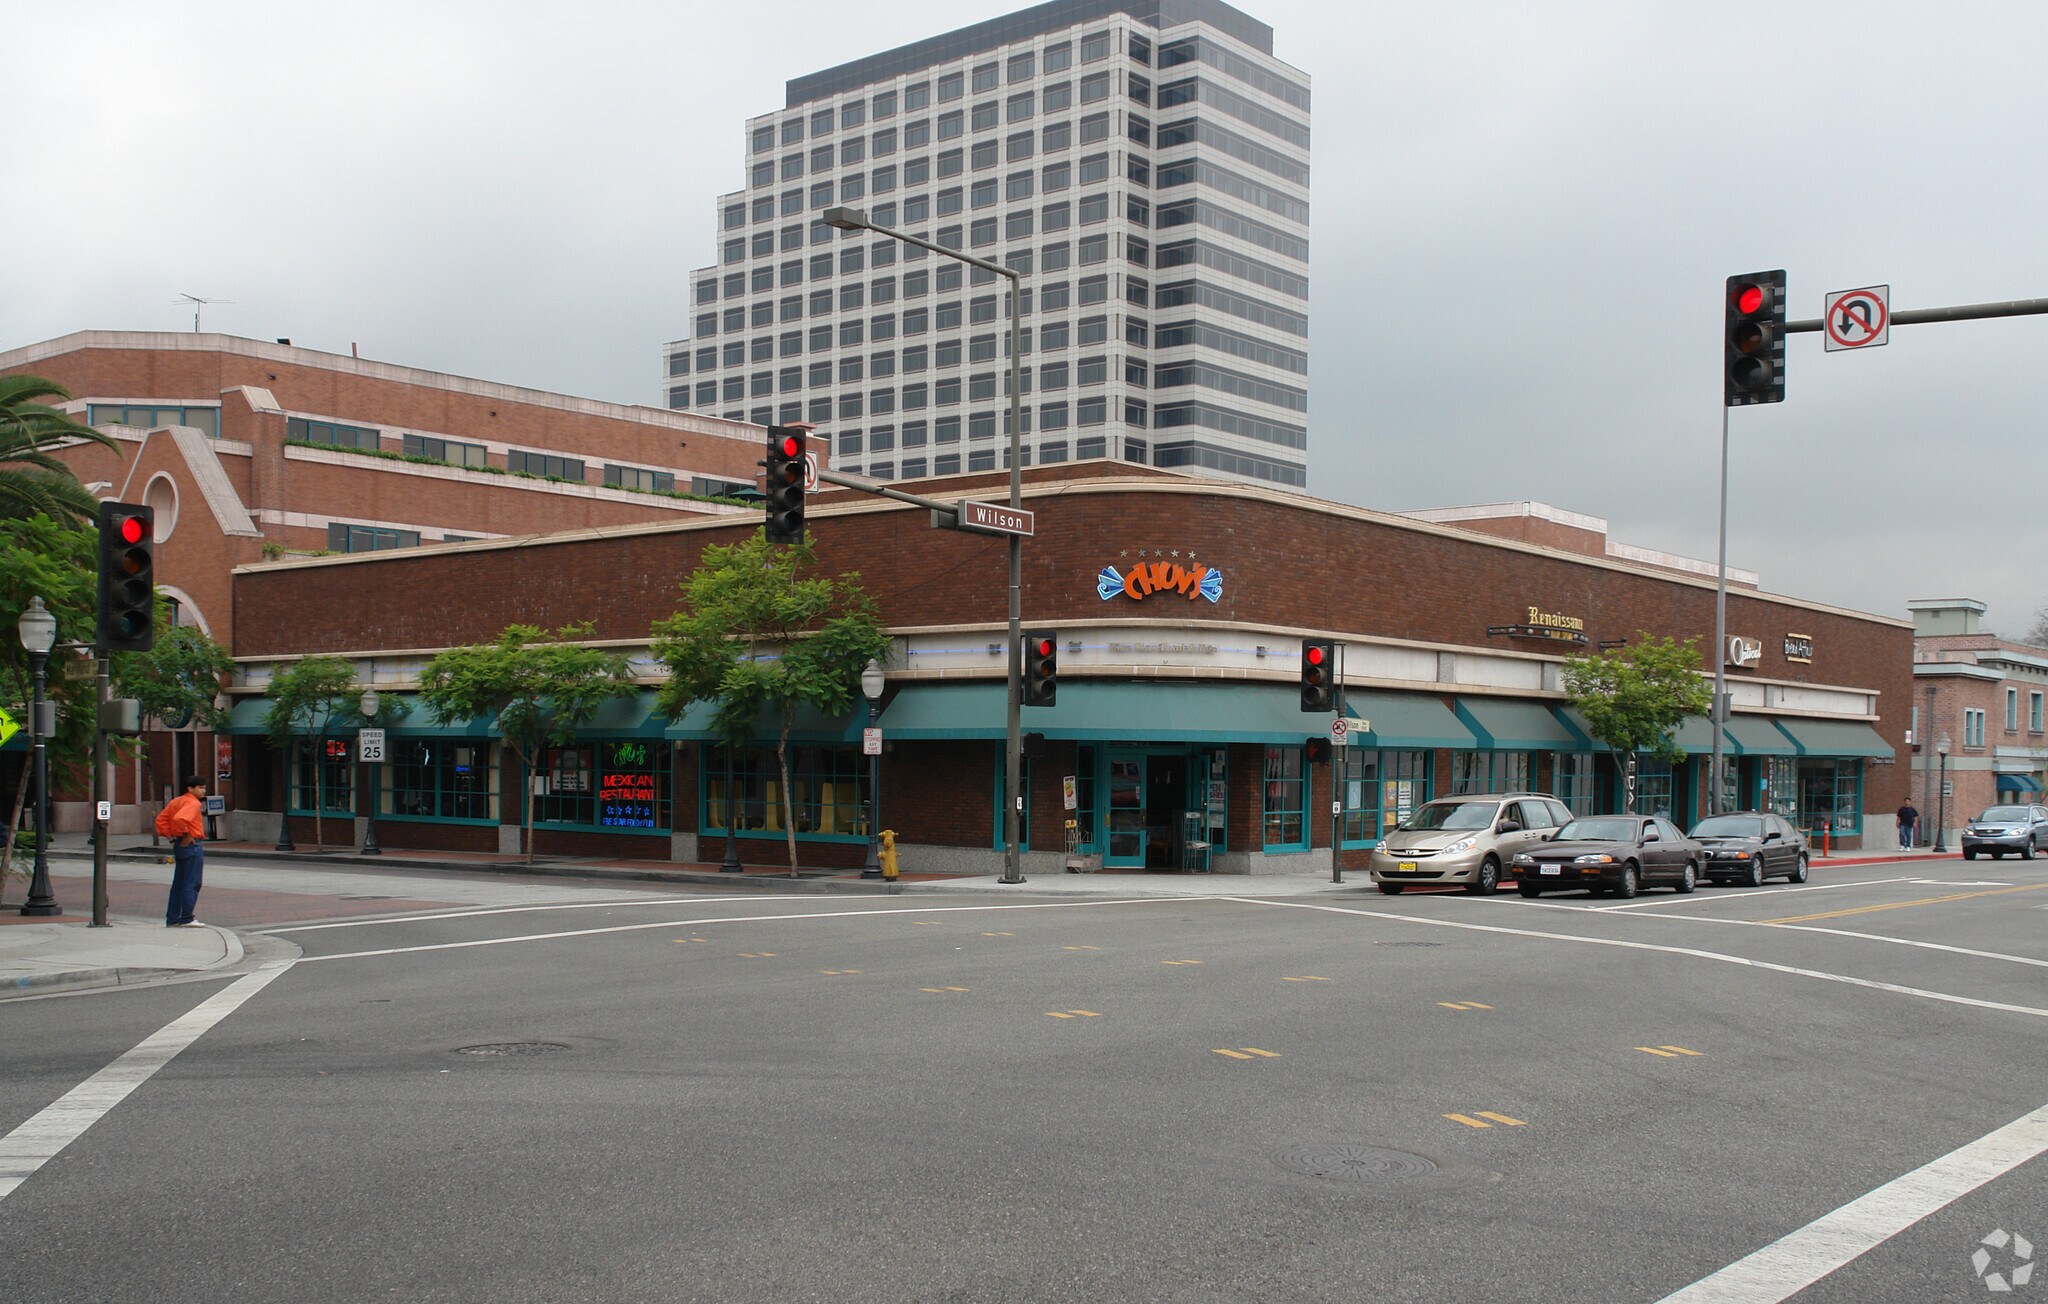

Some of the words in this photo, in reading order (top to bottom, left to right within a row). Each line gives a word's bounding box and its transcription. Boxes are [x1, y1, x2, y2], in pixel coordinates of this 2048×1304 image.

[976, 507, 1022, 529] Wilson
[364, 747, 381, 758] 25
[604, 775, 653, 788] MEXICAN
[600, 788, 653, 801] RESTAURANT
